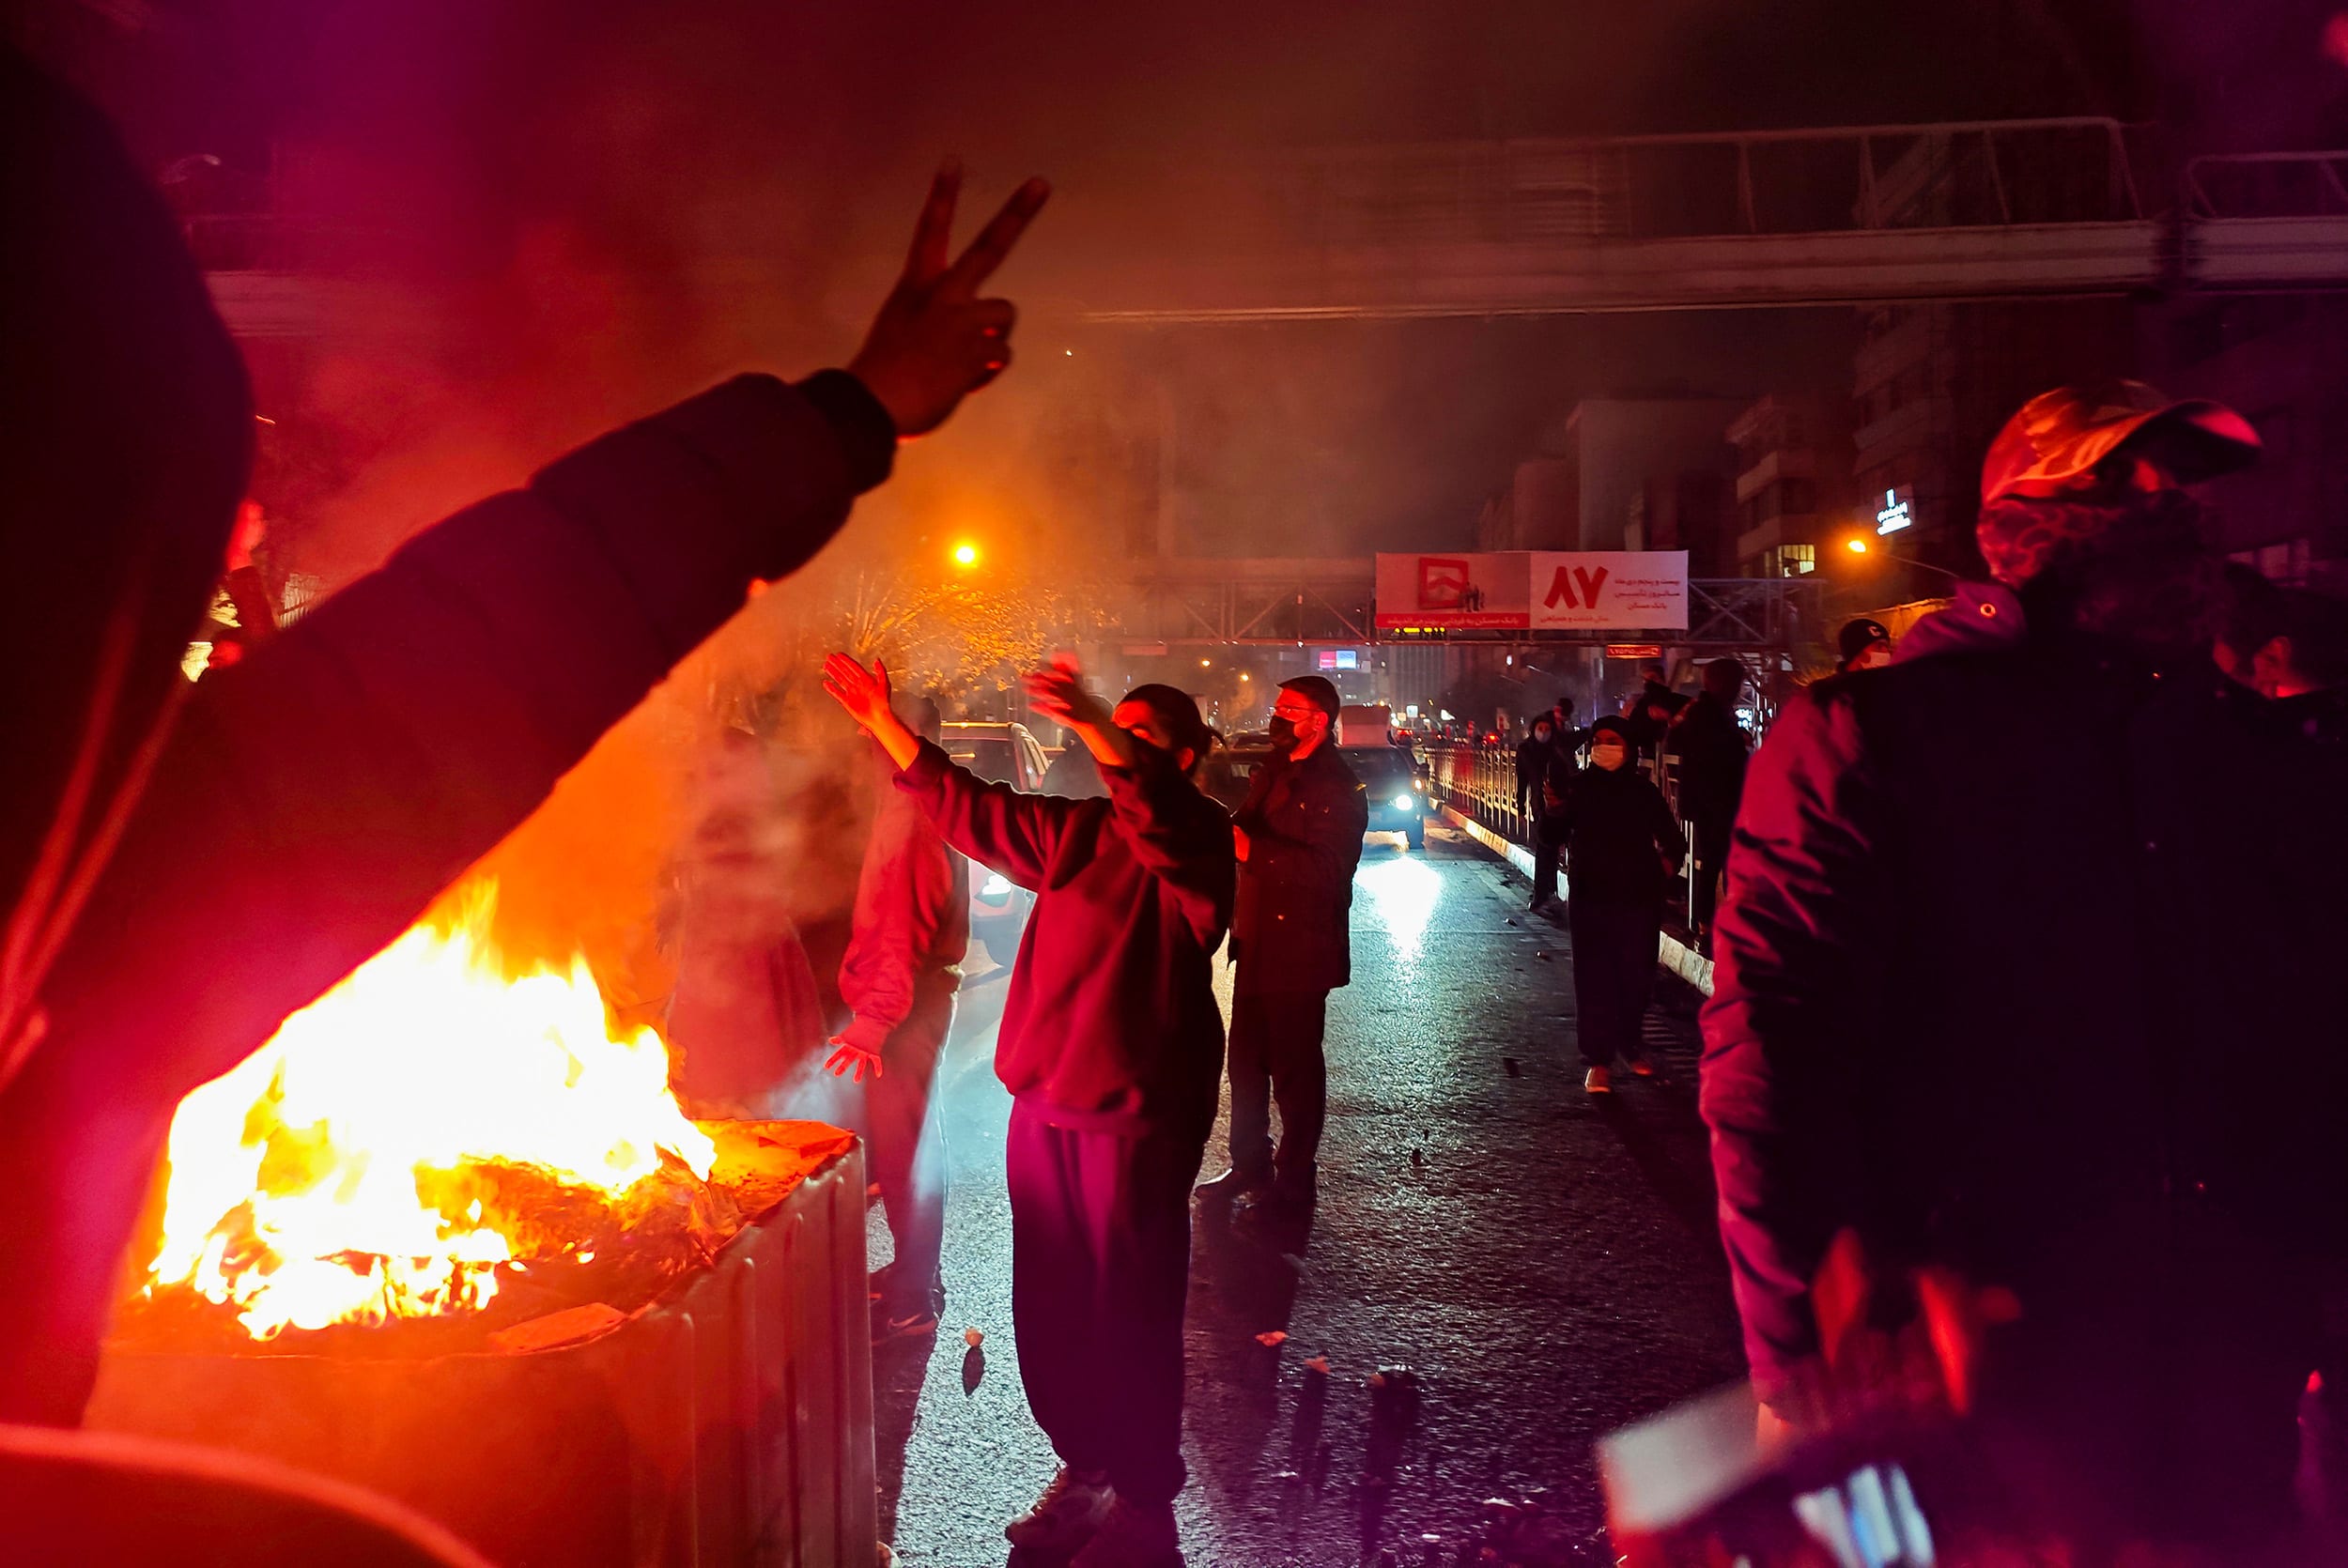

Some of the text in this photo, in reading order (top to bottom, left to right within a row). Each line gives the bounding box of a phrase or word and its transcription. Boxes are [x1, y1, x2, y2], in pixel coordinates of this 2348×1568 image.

[1543, 565, 1609, 609] ۸۷
[1628, 602, 1650, 611] مسکن
[1475, 616, 1500, 626] مسکن
[1501, 616, 1520, 626] بانک
